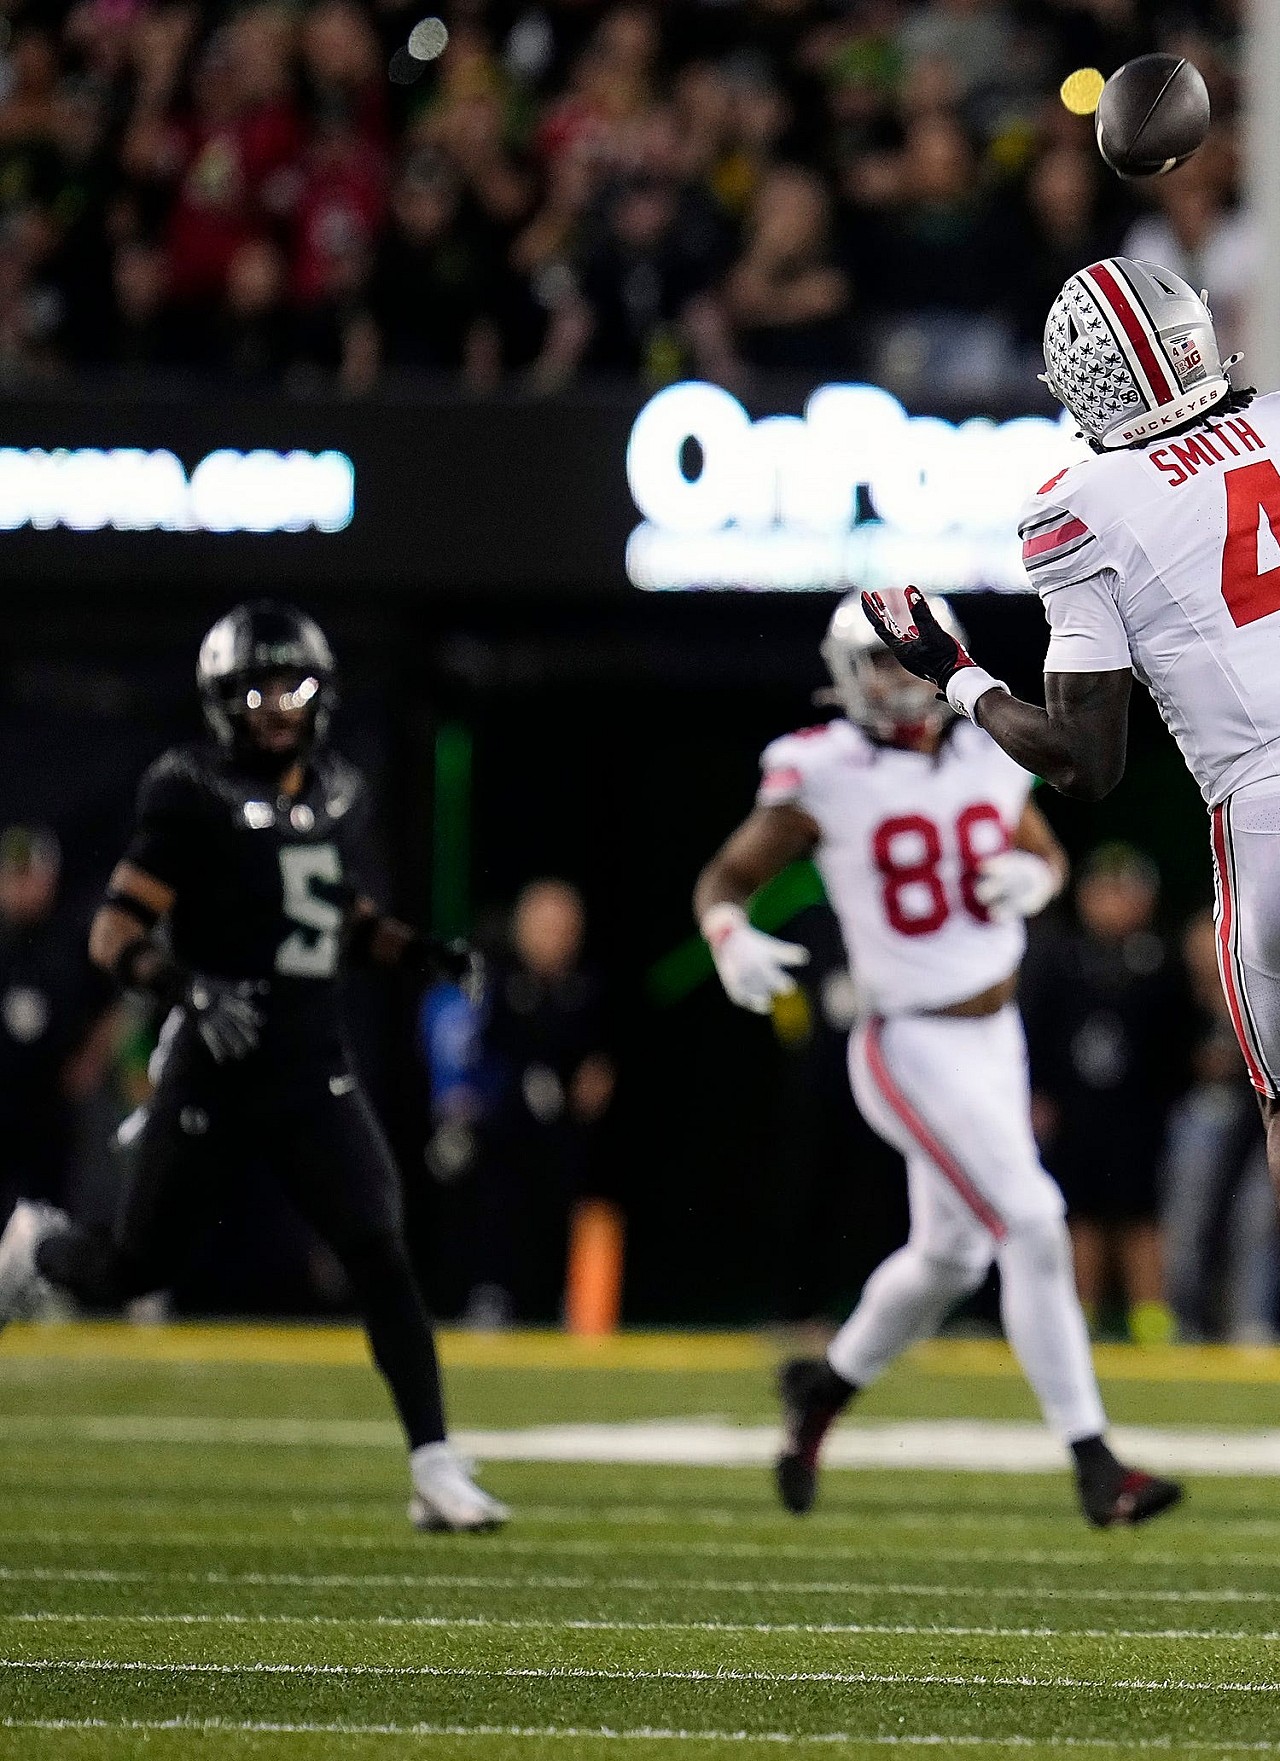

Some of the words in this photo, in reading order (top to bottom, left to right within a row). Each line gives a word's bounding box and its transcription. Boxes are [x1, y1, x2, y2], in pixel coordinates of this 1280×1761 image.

[1122, 390, 1218, 441] BUCKEYES
[1149, 417, 1266, 487] SMITH
[274, 842, 344, 979] 5
